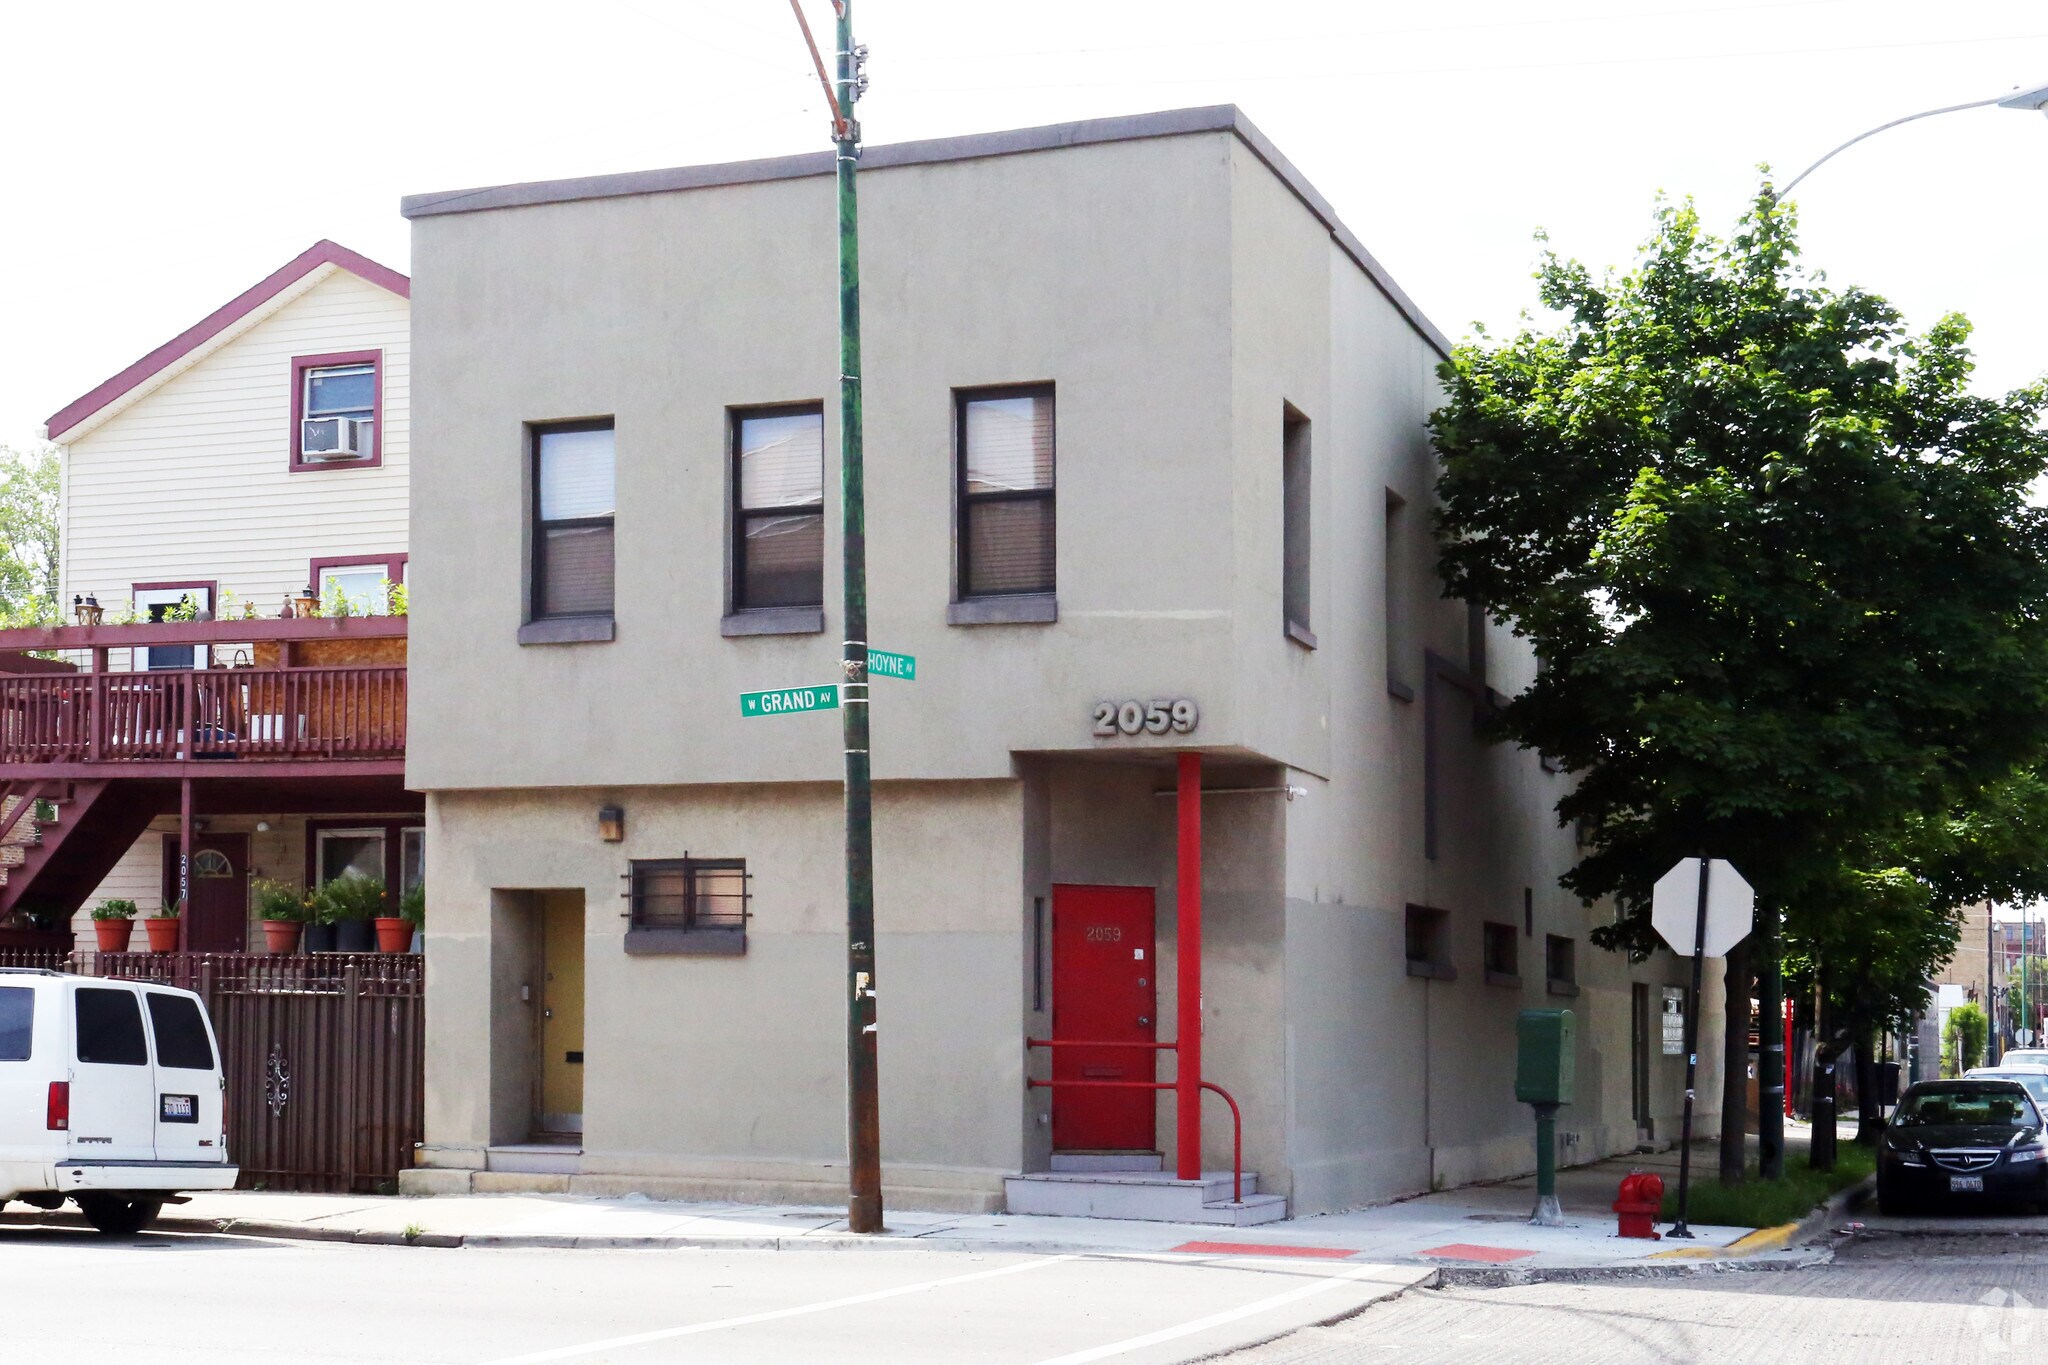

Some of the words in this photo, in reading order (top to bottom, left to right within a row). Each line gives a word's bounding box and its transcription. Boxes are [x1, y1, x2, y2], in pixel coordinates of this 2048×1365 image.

[868, 652, 904, 675] HOYNE
[906, 663, 913, 673] AV
[748, 699, 756, 710] W
[761, 690, 815, 713] GRAND
[820, 692, 831, 703] AV
[1093, 699, 1198, 736] 2059
[1086, 927, 1121, 942] 2059
